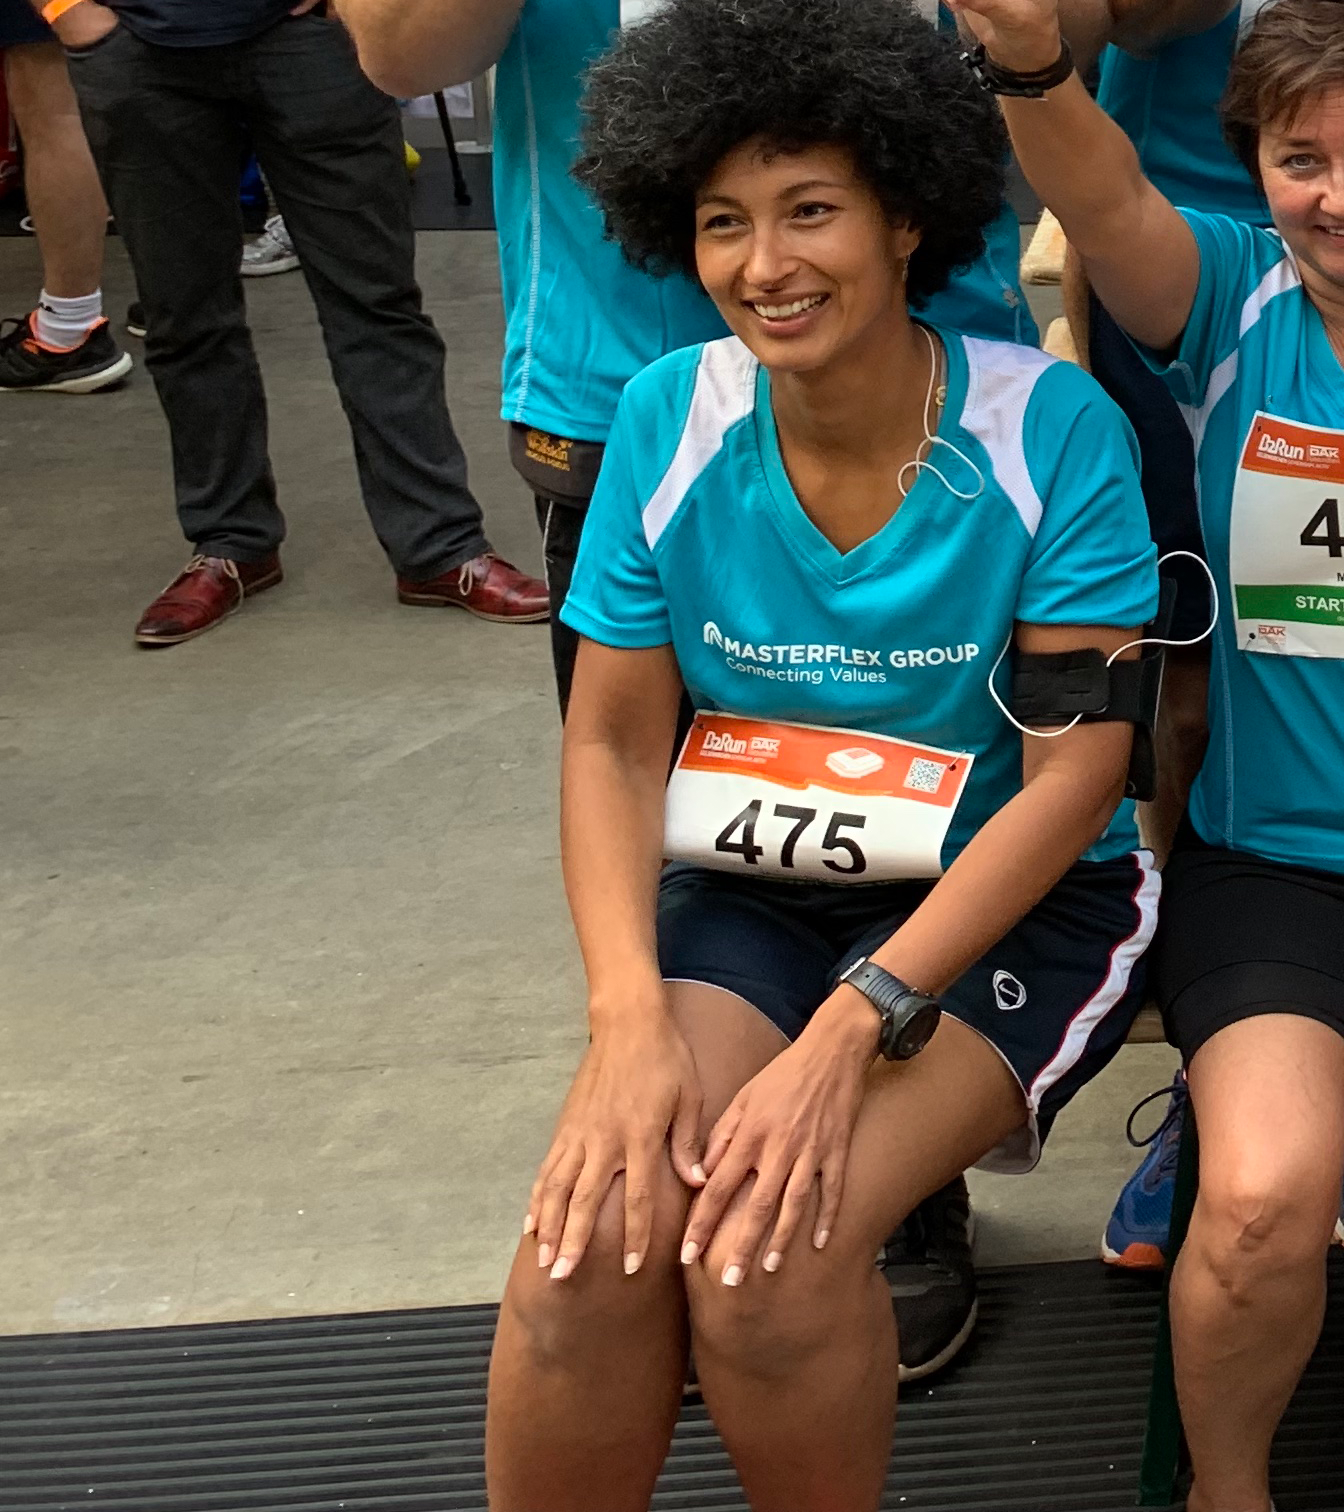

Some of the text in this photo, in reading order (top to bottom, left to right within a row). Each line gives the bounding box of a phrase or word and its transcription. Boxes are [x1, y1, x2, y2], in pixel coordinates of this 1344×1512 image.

[724, 637, 979, 668] MASTERFLEX GROUP
[725, 656, 887, 684] Connecting Values
[715, 799, 867, 875] 475
